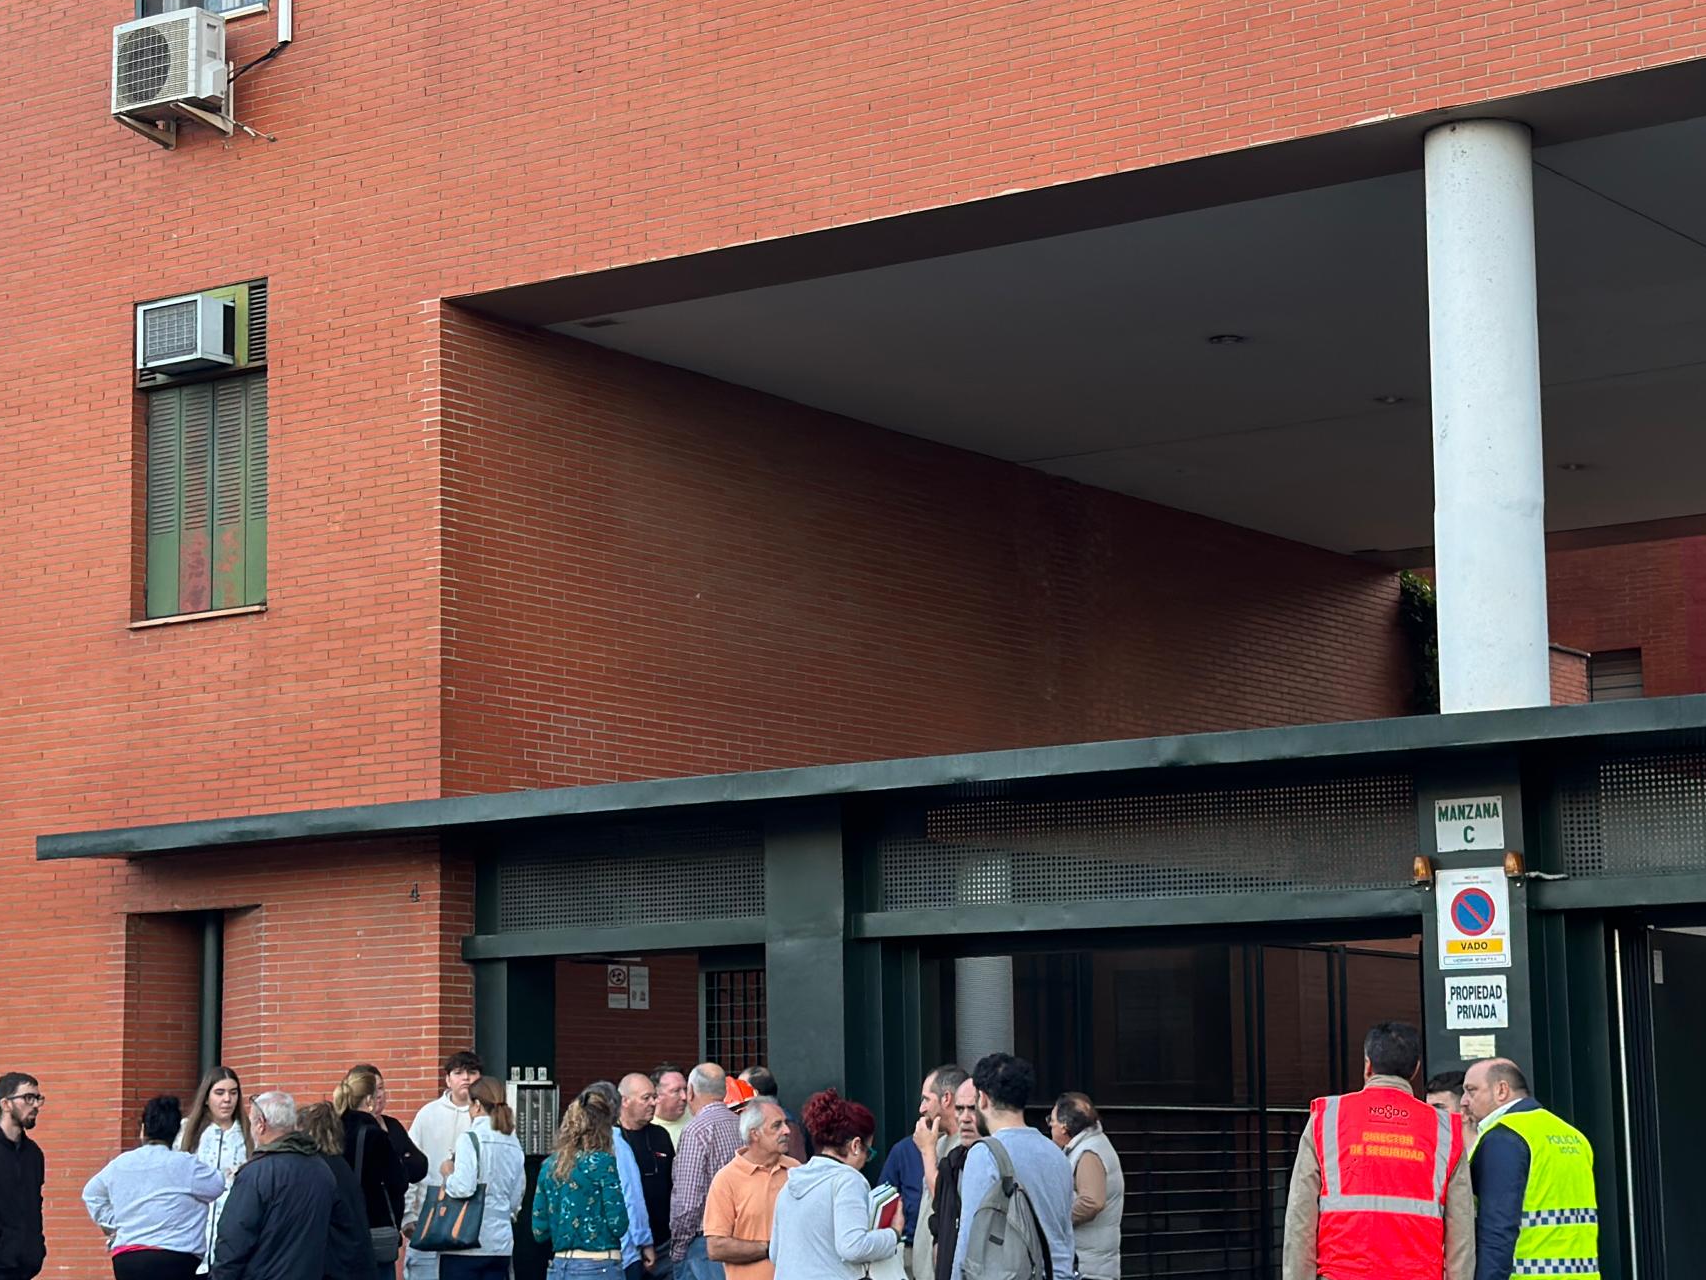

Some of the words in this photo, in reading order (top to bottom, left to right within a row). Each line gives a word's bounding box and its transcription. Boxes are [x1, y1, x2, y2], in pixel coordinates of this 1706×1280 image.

[1438, 802, 1500, 822] MANZANA
[1463, 825, 1475, 843] C
[1461, 941, 1488, 950] VADO
[1450, 985, 1502, 1000] PROPIEDAD
[1457, 1004, 1497, 1019] PRIVADA
[1362, 1131, 1414, 1145] DIRECTOR
[1349, 1144, 1363, 1155] DE
[1366, 1144, 1425, 1162] SEGURIDAD
